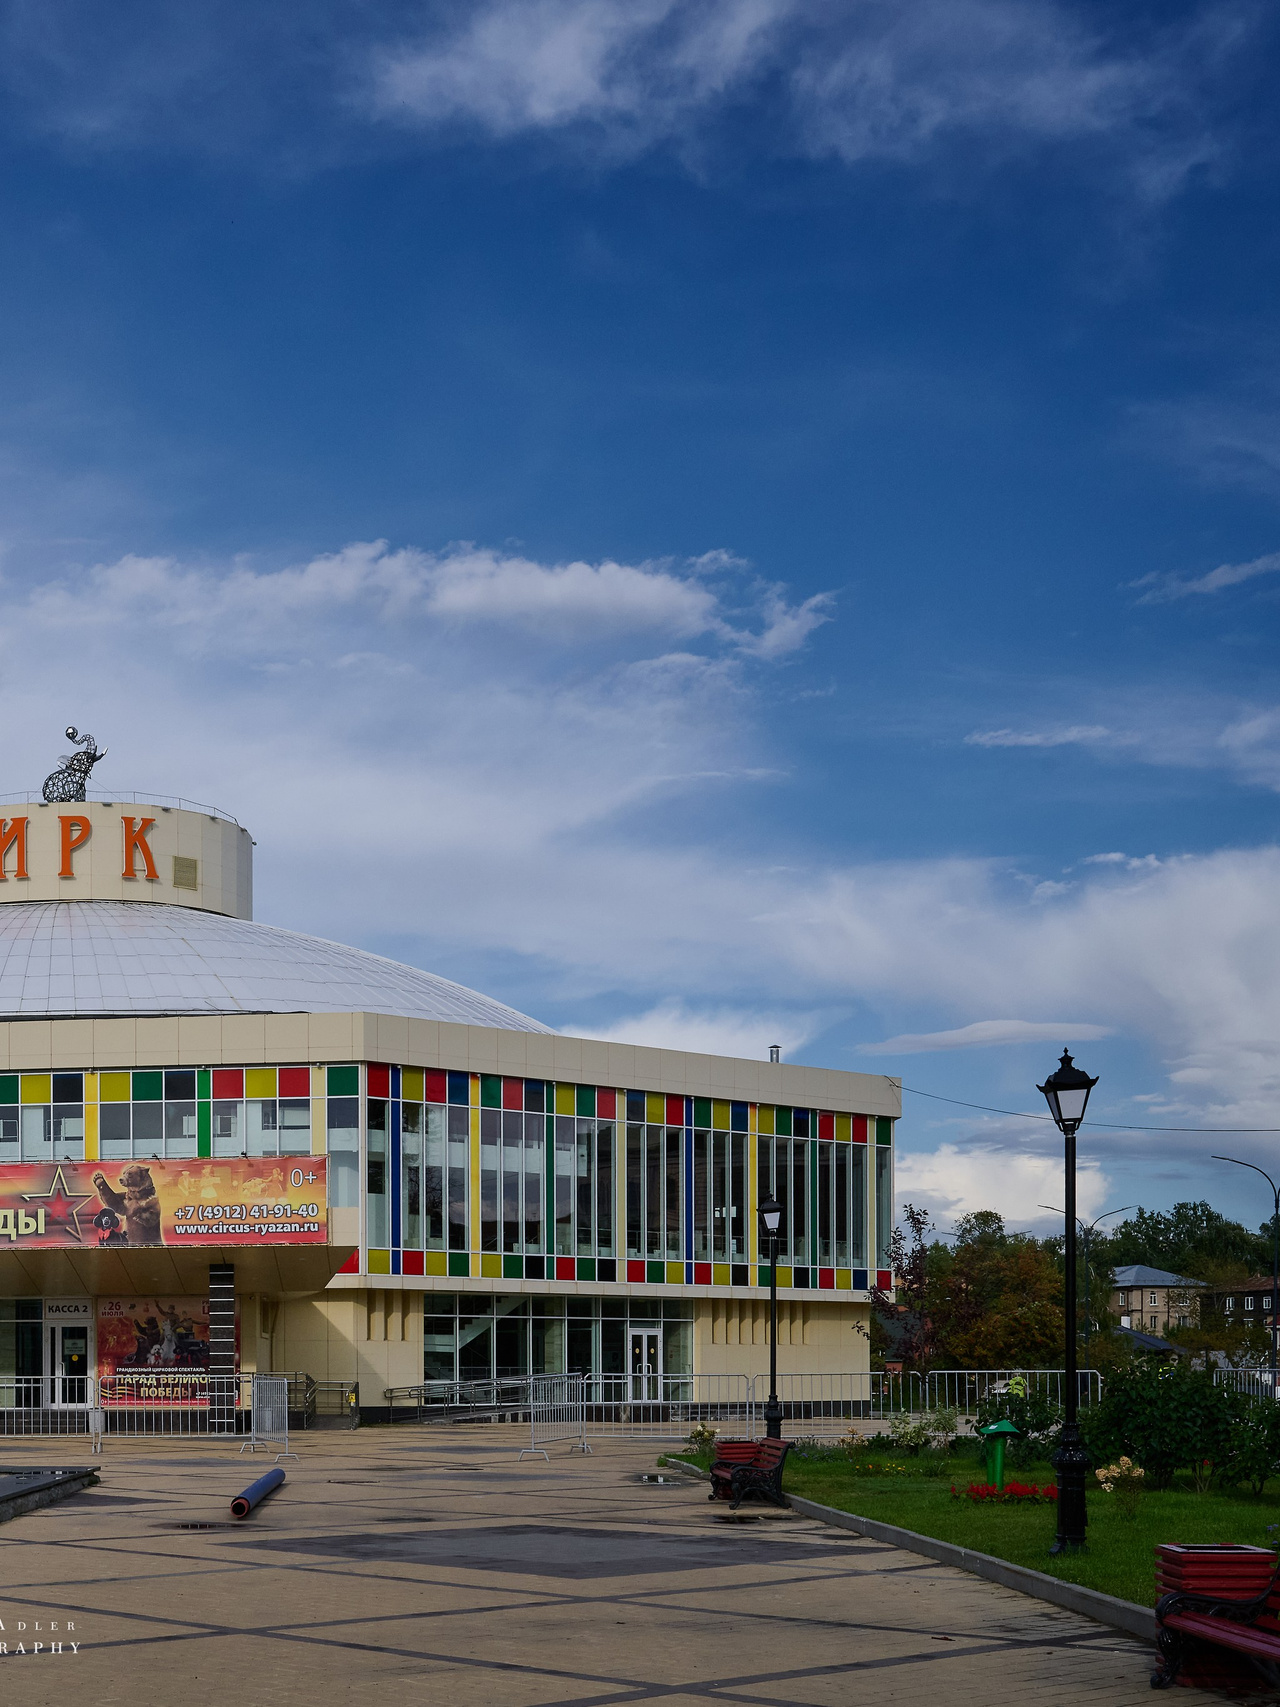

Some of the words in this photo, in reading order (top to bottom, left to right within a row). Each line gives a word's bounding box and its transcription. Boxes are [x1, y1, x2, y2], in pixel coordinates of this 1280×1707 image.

[290, 1168, 317, 1187] 0+
[175, 1206, 195, 1219] +7
[198, 1205, 247, 1221] (4912)
[250, 1203, 319, 1219] 41-91-40
[175, 1221, 319, 1236] www.circus-ryazan.ru
[48, 1305, 80, 1313] КАССА
[82, 1305, 88, 1313] 2
[108, 1301, 121, 1311] 26
[160, 1374, 210, 1384] ВЕЛИКО
[140, 1387, 192, 1399] ПОБЕДЫ
